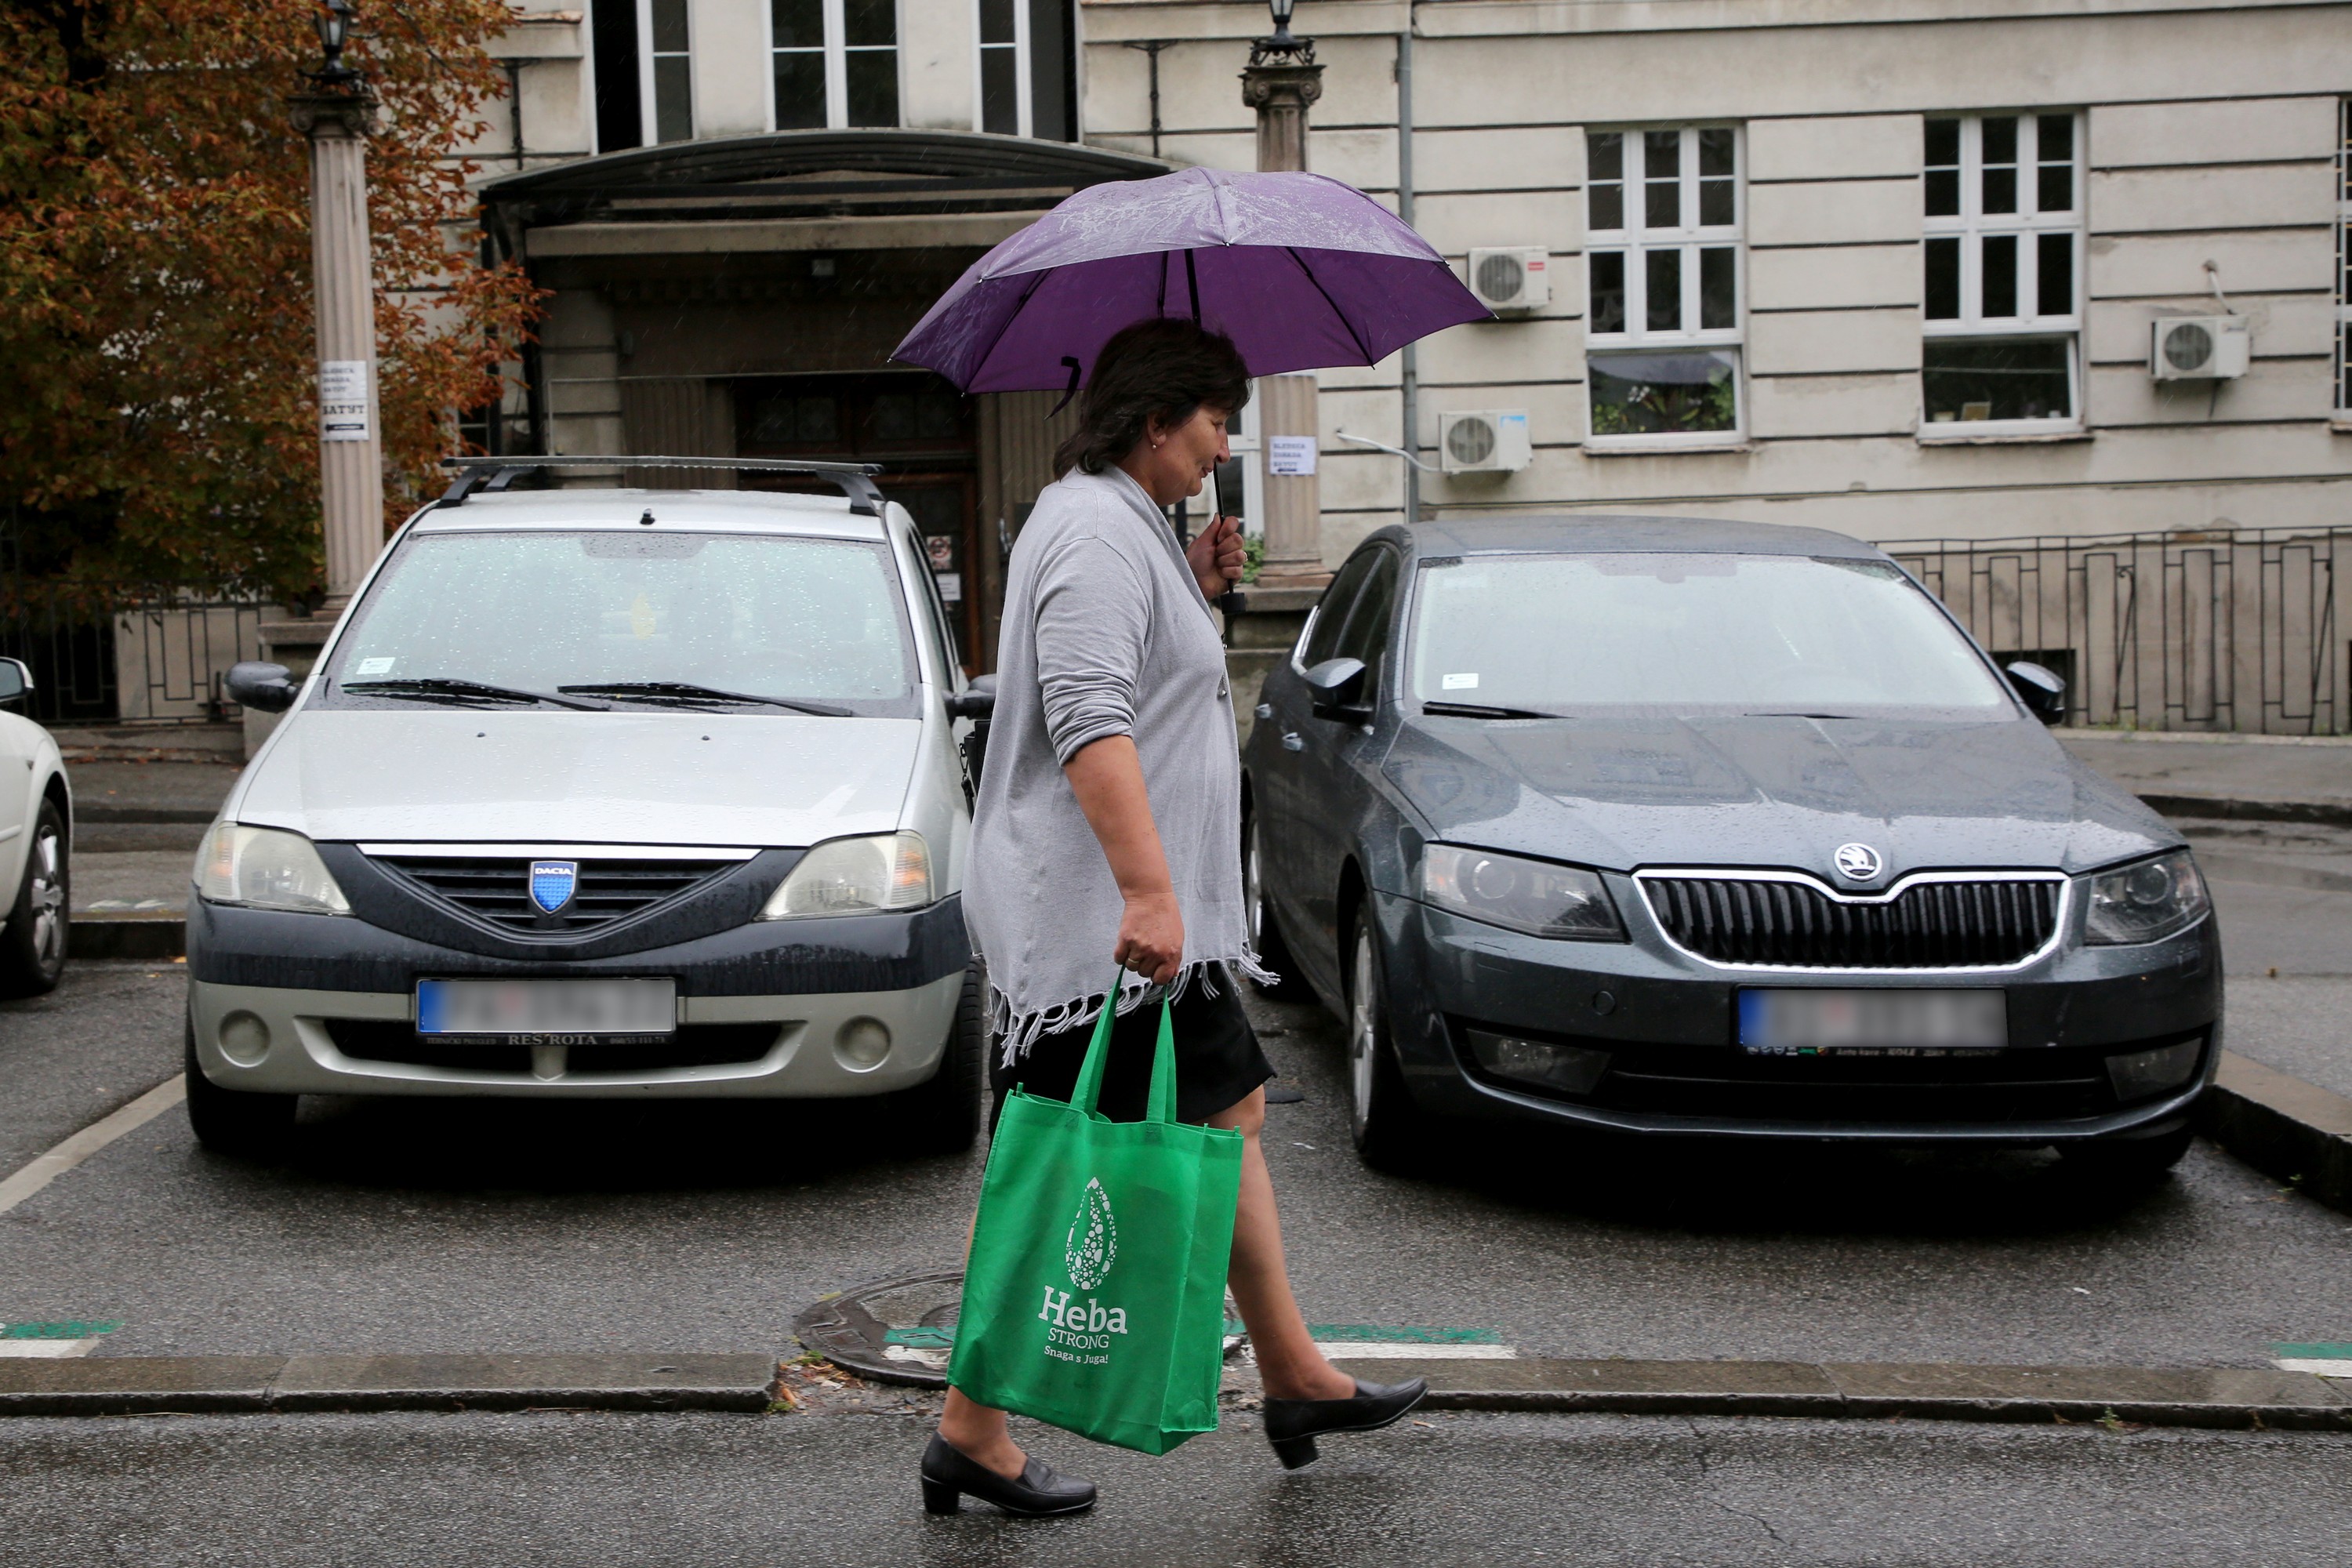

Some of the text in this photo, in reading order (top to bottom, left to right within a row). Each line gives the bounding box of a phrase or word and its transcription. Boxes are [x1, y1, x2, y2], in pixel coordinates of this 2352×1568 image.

[549, 1035, 598, 1045] ROTA
[1038, 1285, 1127, 1334] Heba
[1048, 1327, 1109, 1348] STRONG
[1044, 1345, 1074, 1361] Snaga
[1083, 1354, 1109, 1365] Juga!
